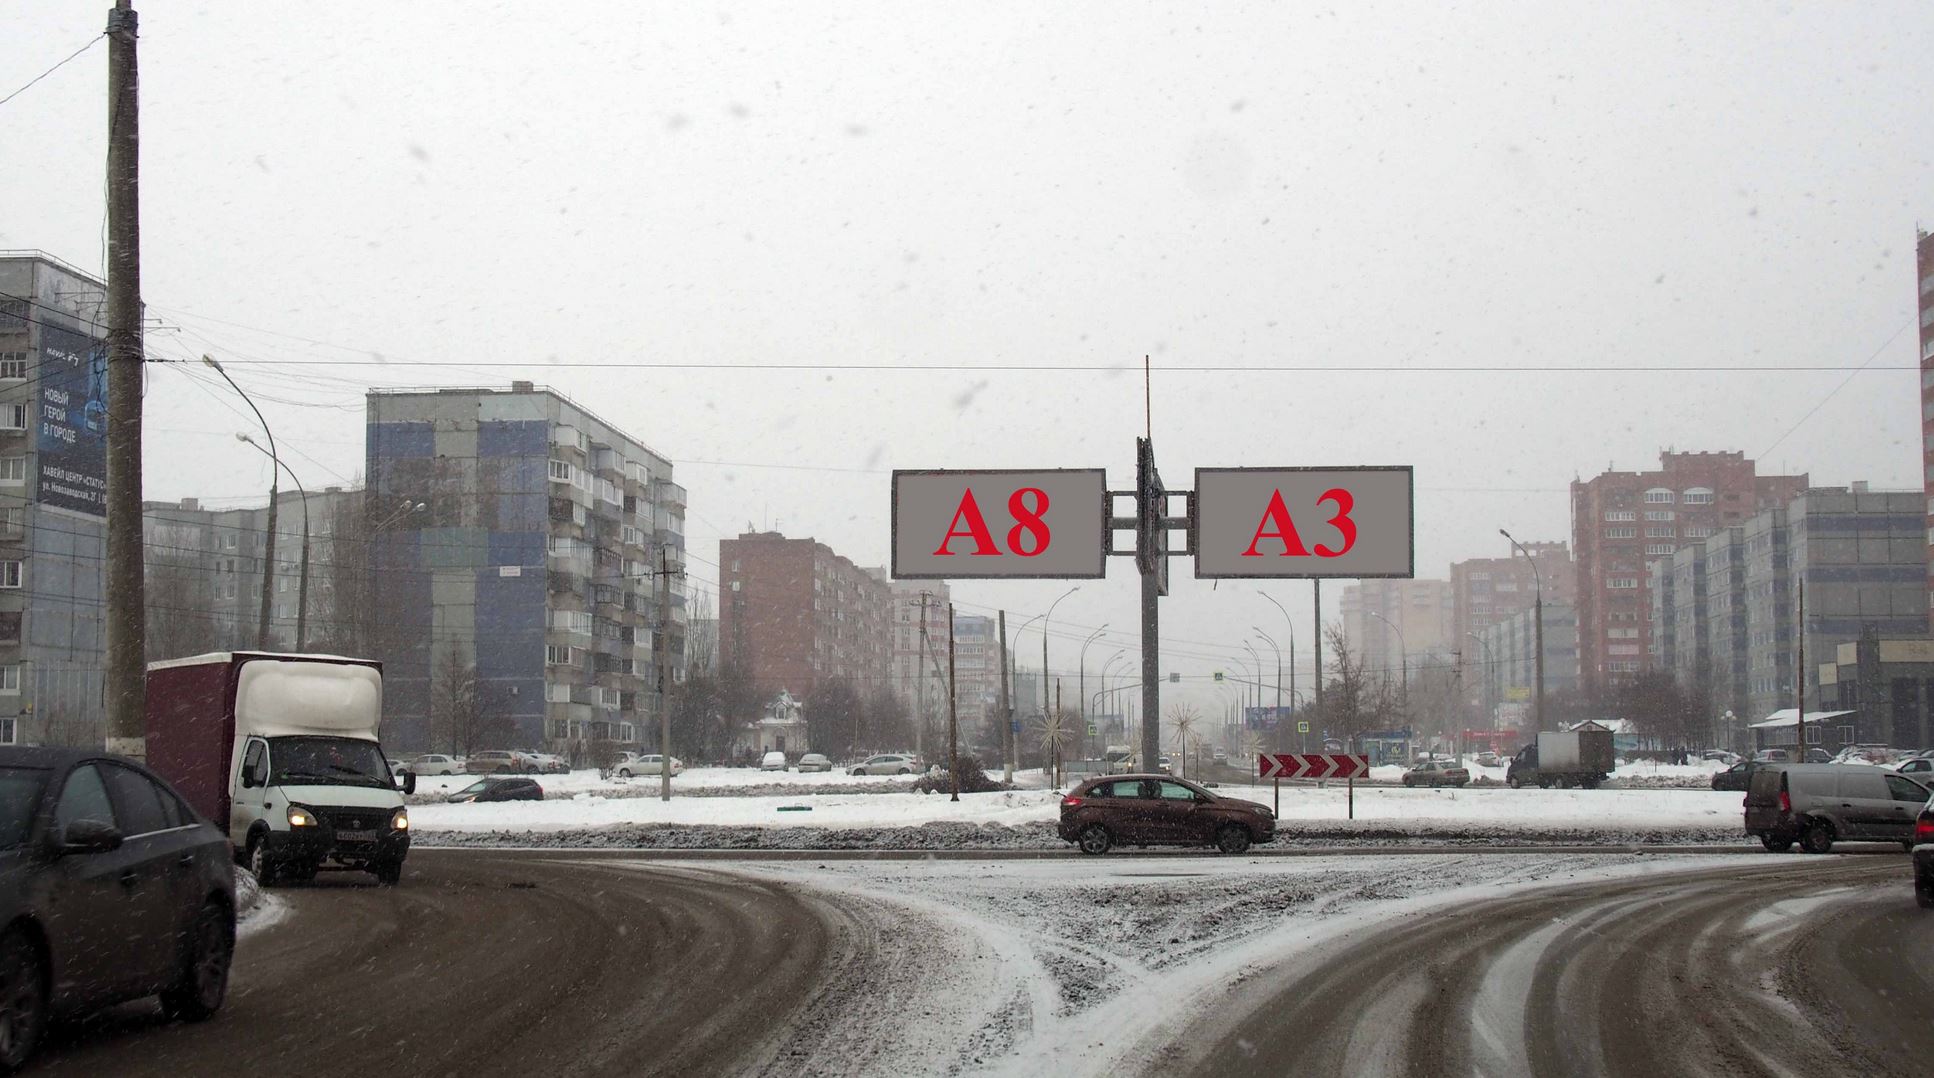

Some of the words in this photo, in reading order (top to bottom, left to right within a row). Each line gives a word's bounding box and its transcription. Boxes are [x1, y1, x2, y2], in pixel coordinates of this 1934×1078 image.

[44, 387, 69, 406] НОВЫЙ
[44, 404, 66, 422] ГЕРОЙ
[43, 422, 49, 435] В
[50, 424, 76, 444] ГОРОДЕ
[43, 464, 65, 479] ХАВЕЙЛ
[65, 471, 83, 483] ЦЕНТР
